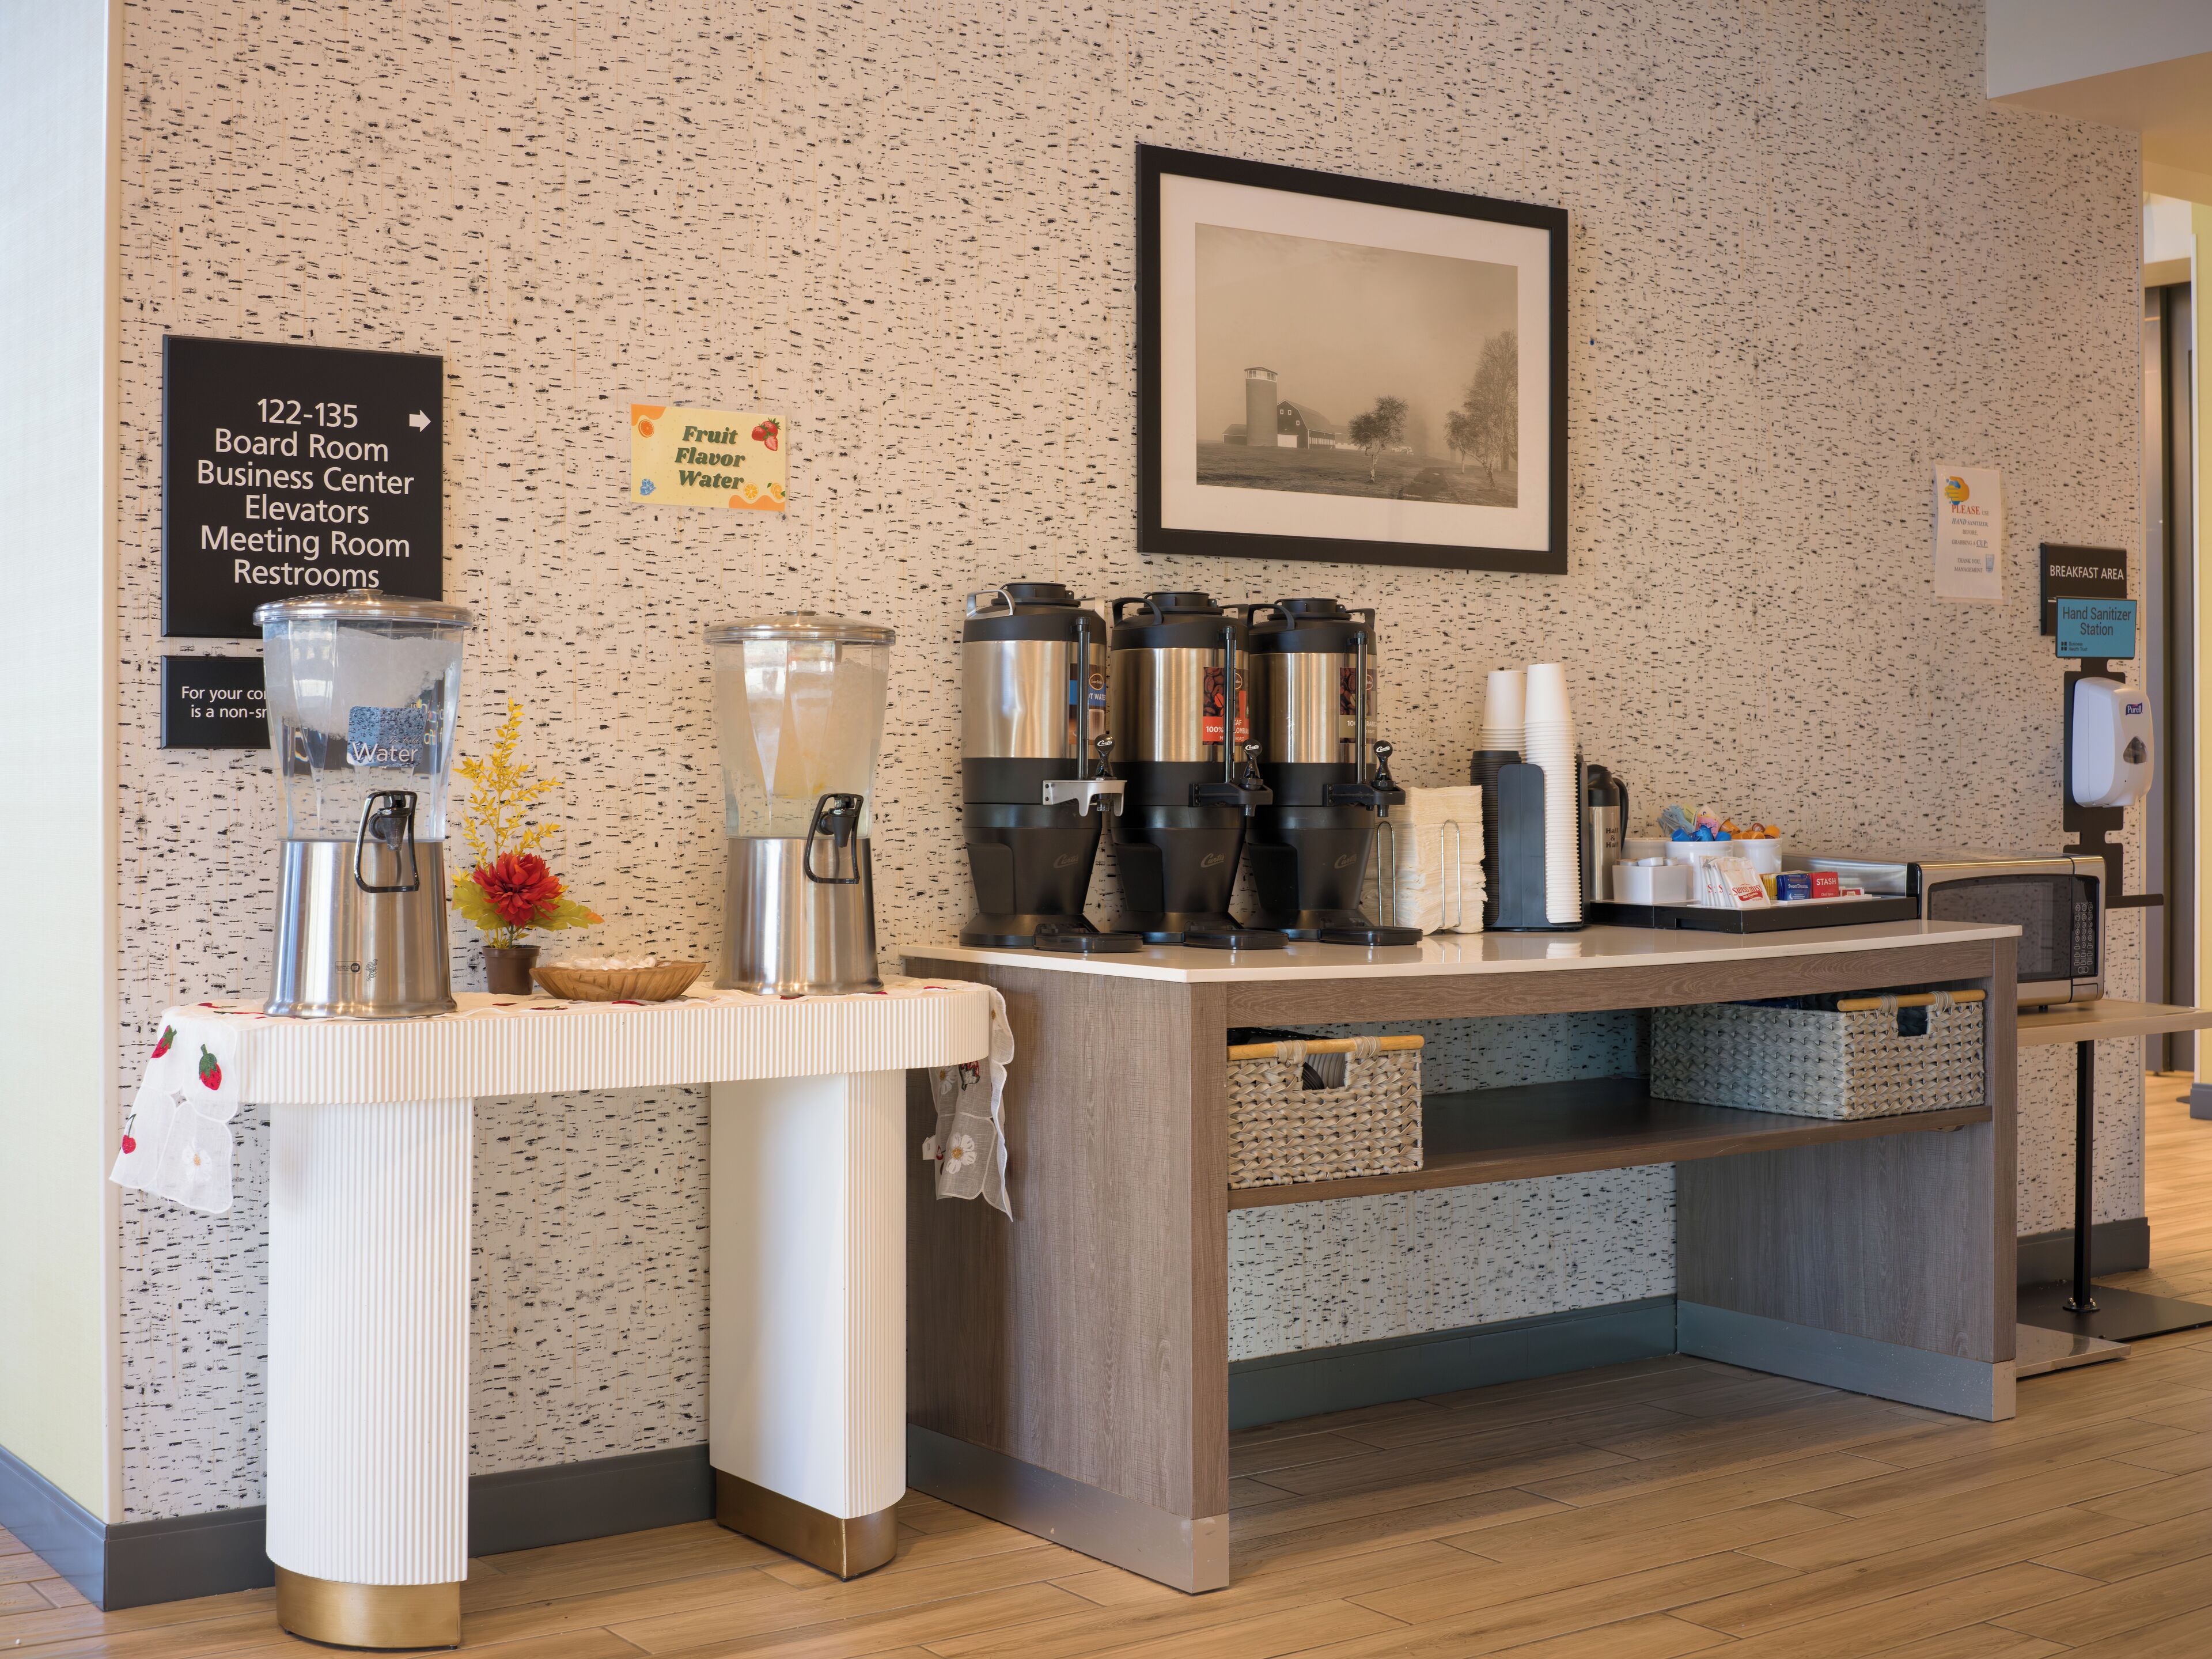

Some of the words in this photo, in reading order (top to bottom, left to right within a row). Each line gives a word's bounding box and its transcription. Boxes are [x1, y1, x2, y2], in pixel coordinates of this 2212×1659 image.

[257, 399, 358, 429] 122-135
[215, 428, 298, 457] Board
[309, 434, 389, 462] Room
[682, 425, 738, 445] Fruit
[675, 446, 745, 467] Flavor
[198, 460, 313, 490] Business
[323, 467, 415, 495] Center
[679, 469, 744, 490] Water
[245, 495, 369, 525] Elevators
[1952, 505, 1980, 516] PLEASE
[201, 525, 320, 560] Meeting
[331, 531, 410, 558] Room
[234, 559, 380, 588] Restrooms
[2050, 565, 2099, 579] BREAKFAST
[2101, 567, 2124, 580] AREA
[2063, 607, 2088, 619] Hand
[2090, 607, 2131, 620] Sanitizer
[2080, 622, 2113, 635] Station
[181, 686, 205, 699] For
[210, 689, 243, 703] your
[191, 704, 201, 718] is
[206, 708, 214, 718] a
[2127, 705, 2141, 714] Purell
[385, 736, 400, 744] Ice
[402, 735, 422, 744] Cold
[351, 742, 418, 762] Water
[1816, 878, 1836, 886] STASH
